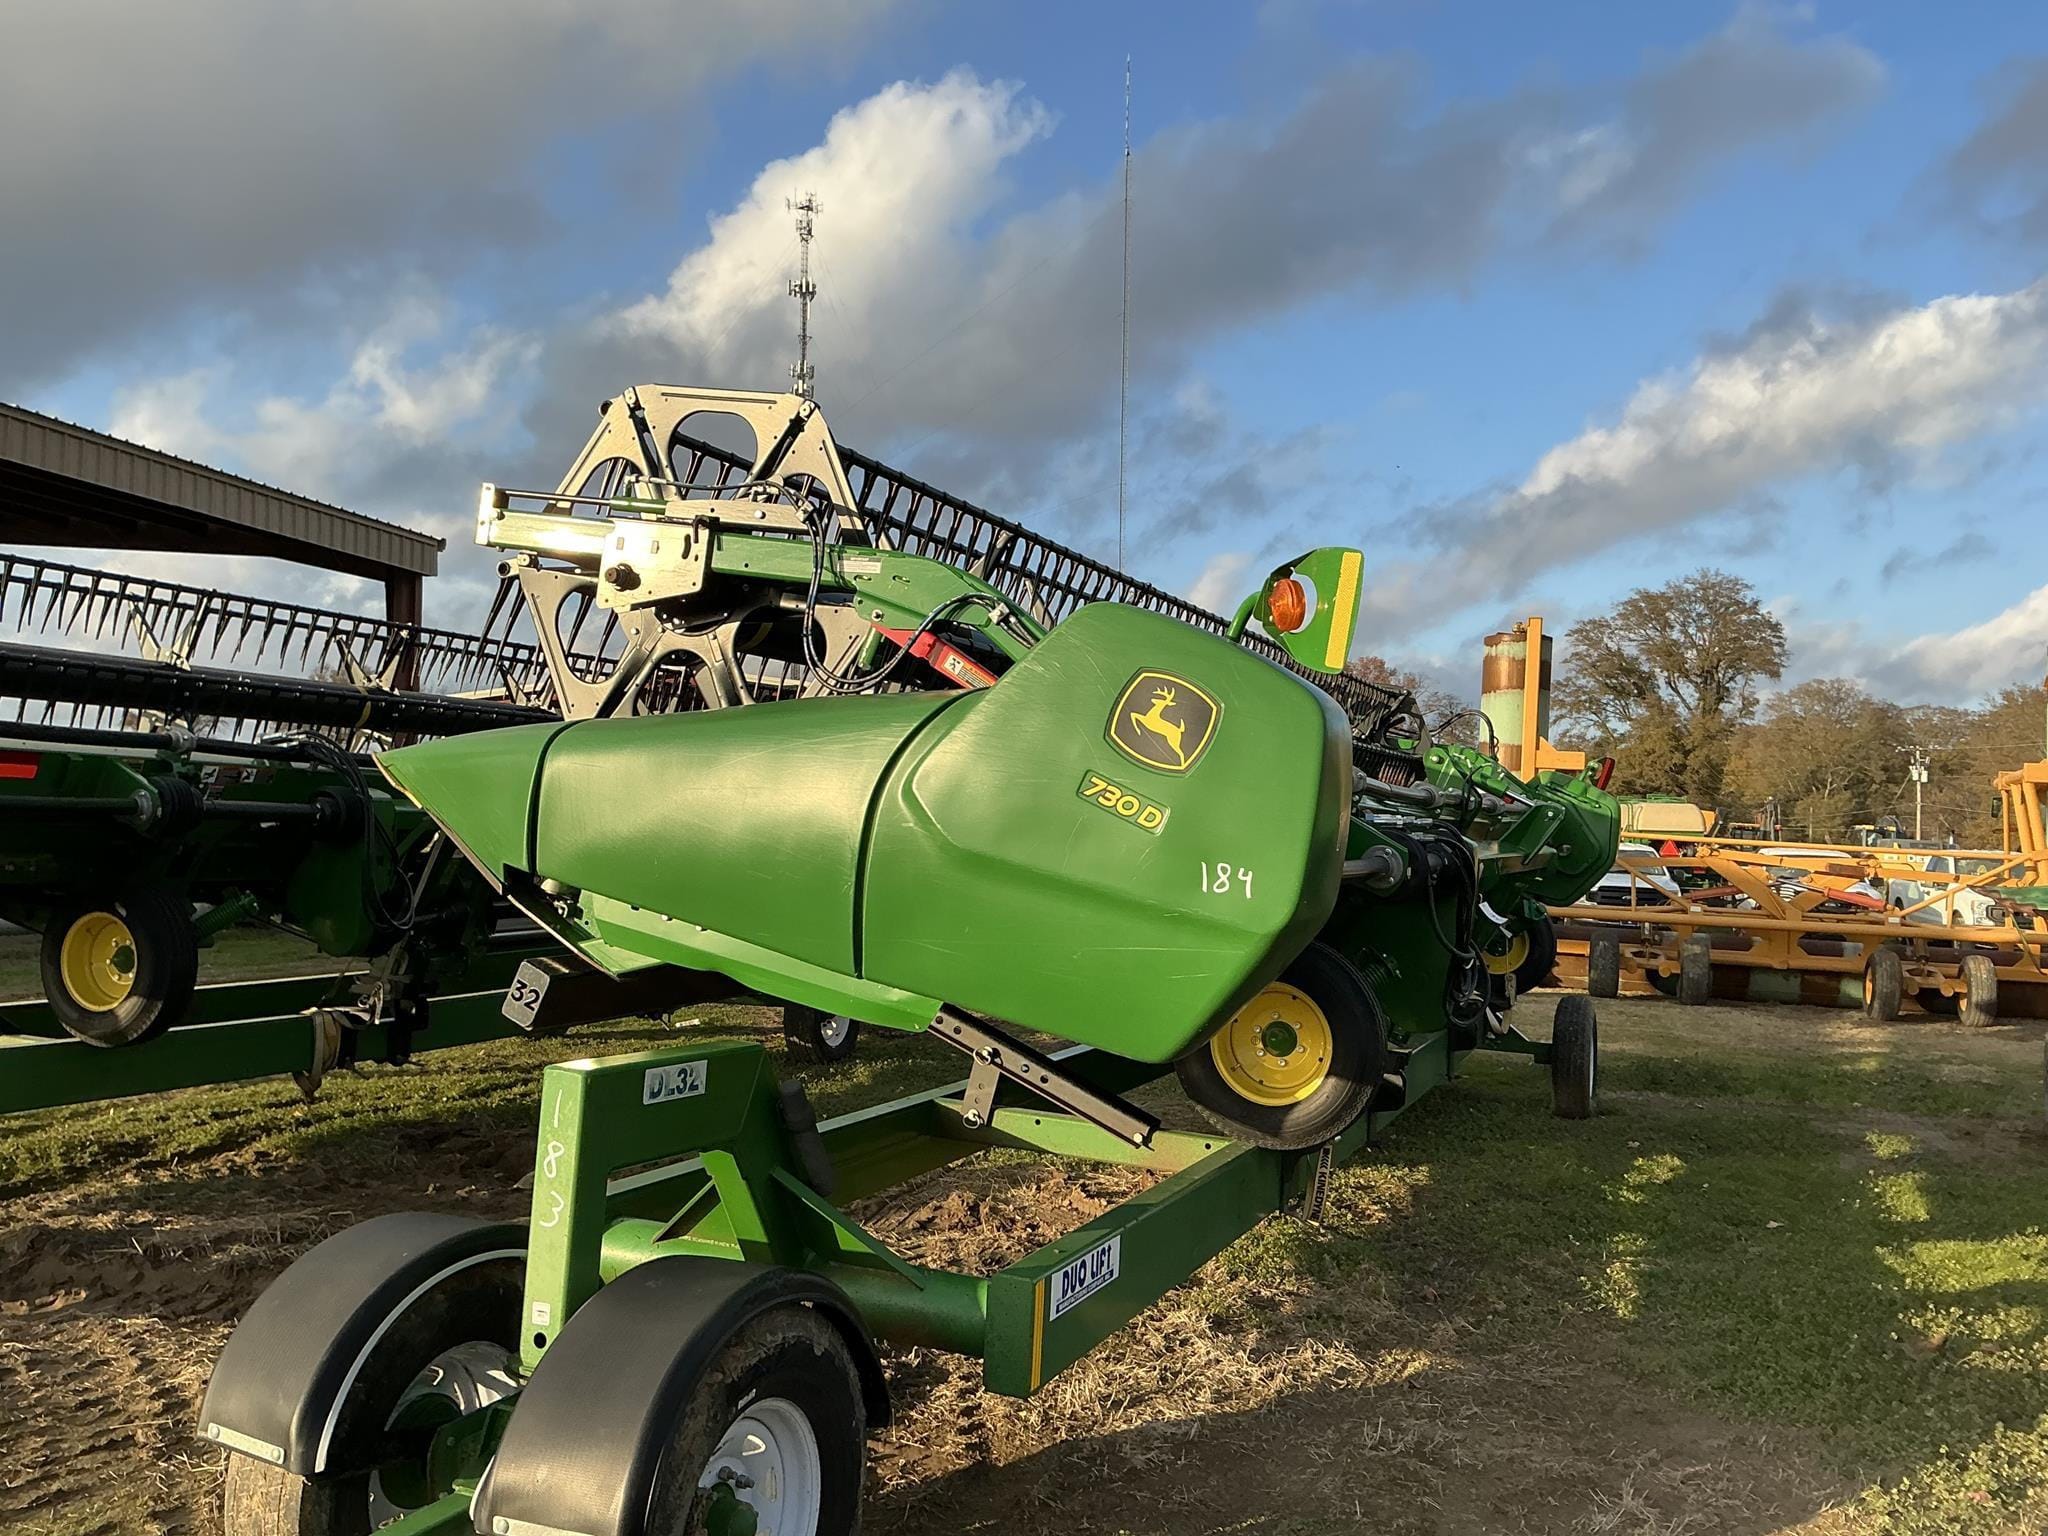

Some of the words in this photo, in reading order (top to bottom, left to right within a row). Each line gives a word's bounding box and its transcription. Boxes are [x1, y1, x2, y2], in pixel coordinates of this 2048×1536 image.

[1200, 861, 1253, 899] 184
[511, 979, 541, 1012] 32
[649, 1067, 699, 1100] DL32
[539, 1088, 565, 1228] 183
[1061, 1258, 1087, 1299] DUO
